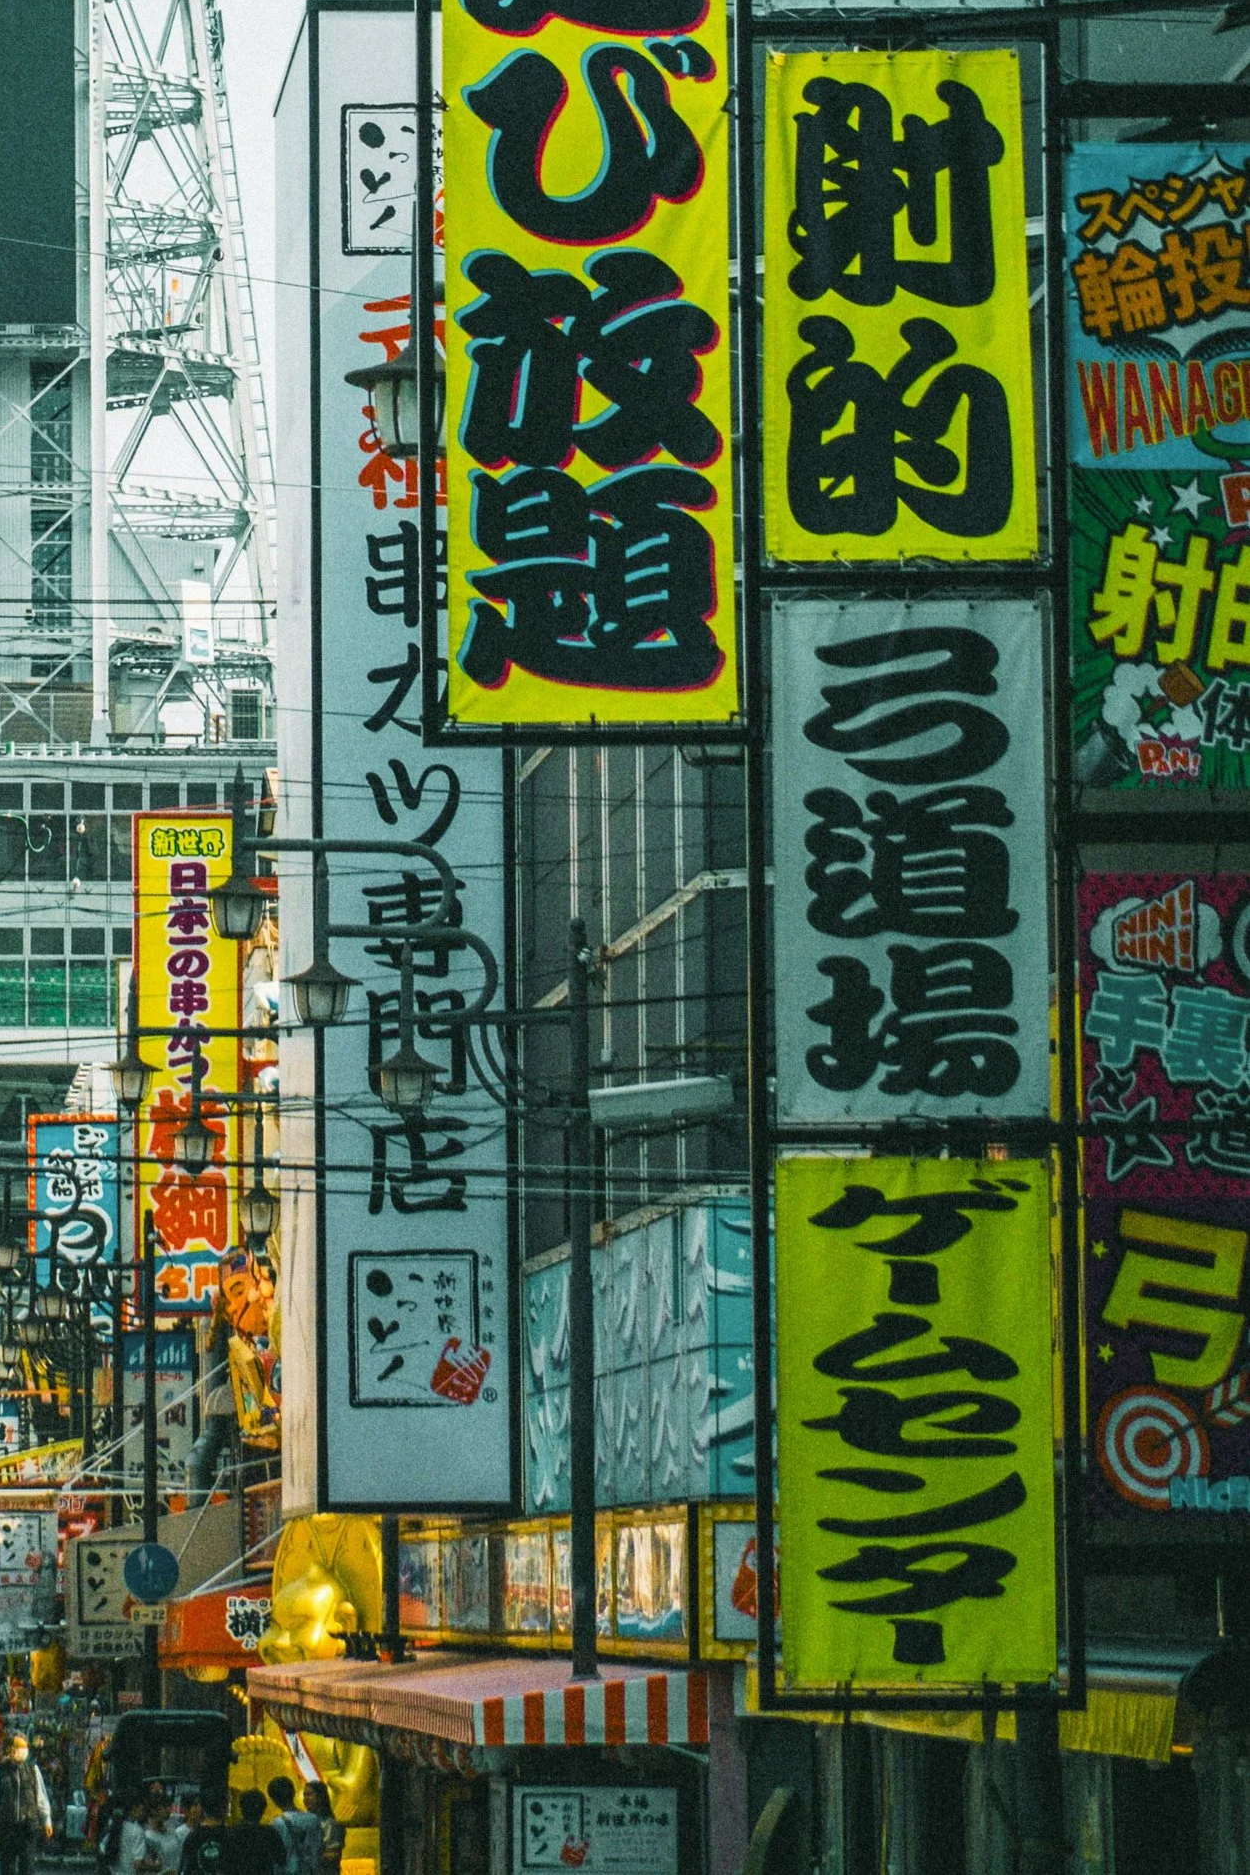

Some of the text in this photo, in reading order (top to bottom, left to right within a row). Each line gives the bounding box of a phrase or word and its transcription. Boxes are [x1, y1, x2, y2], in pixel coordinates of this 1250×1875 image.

[1074, 223, 1250, 338] 輪投
[1080, 175, 1250, 239] スペシャ
[786, 76, 1014, 537] 射的
[1136, 739, 1201, 775] PAN!
[151, 828, 224, 858] 新世界
[802, 626, 1021, 1097] 弓道場
[167, 862, 211, 1084] 日本一の串かつ
[1086, 974, 1250, 1088] 手裏
[1102, 1208, 1248, 1389] 弓
[801, 1178, 1030, 1665] ゲームセンター
